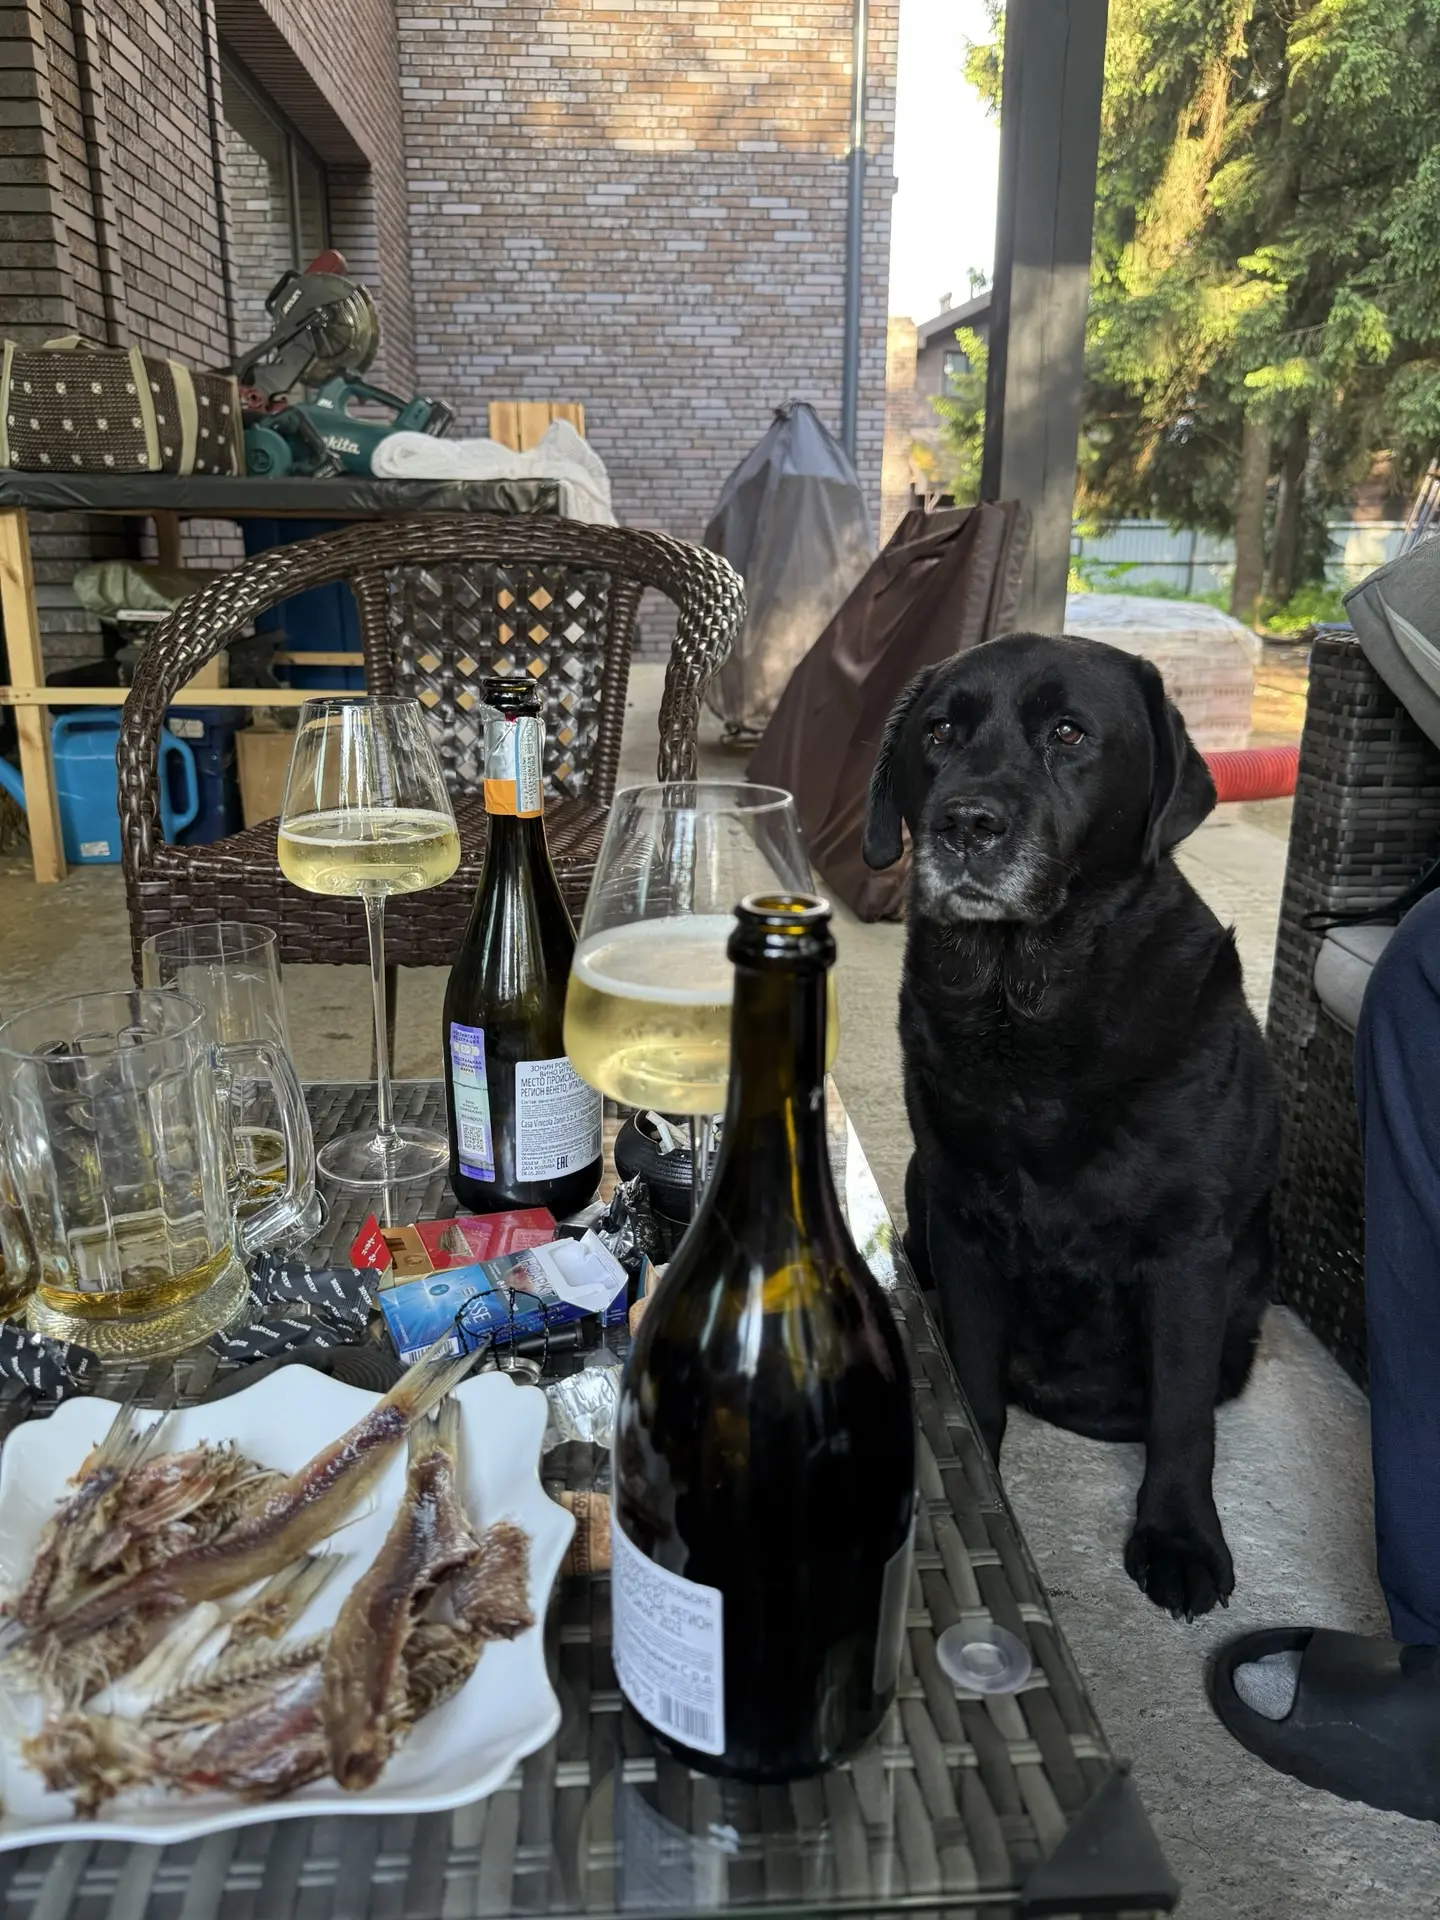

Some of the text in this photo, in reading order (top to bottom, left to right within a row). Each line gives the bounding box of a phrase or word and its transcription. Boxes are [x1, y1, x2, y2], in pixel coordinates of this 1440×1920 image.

[530, 1064, 554, 1072] ЗОНИН
[540, 1069, 558, 1077] ВИНО
[521, 1071, 581, 1087] МЕСТО ПРОИСХО
[520, 1087, 545, 1097] РЕГИОН
[546, 1083, 568, 1095] ВЕНЕТО,
[521, 1120, 533, 1128] Casa
[533, 1118, 553, 1128] Vinicola
[671, 1604, 713, 1631] РЕГИОН
